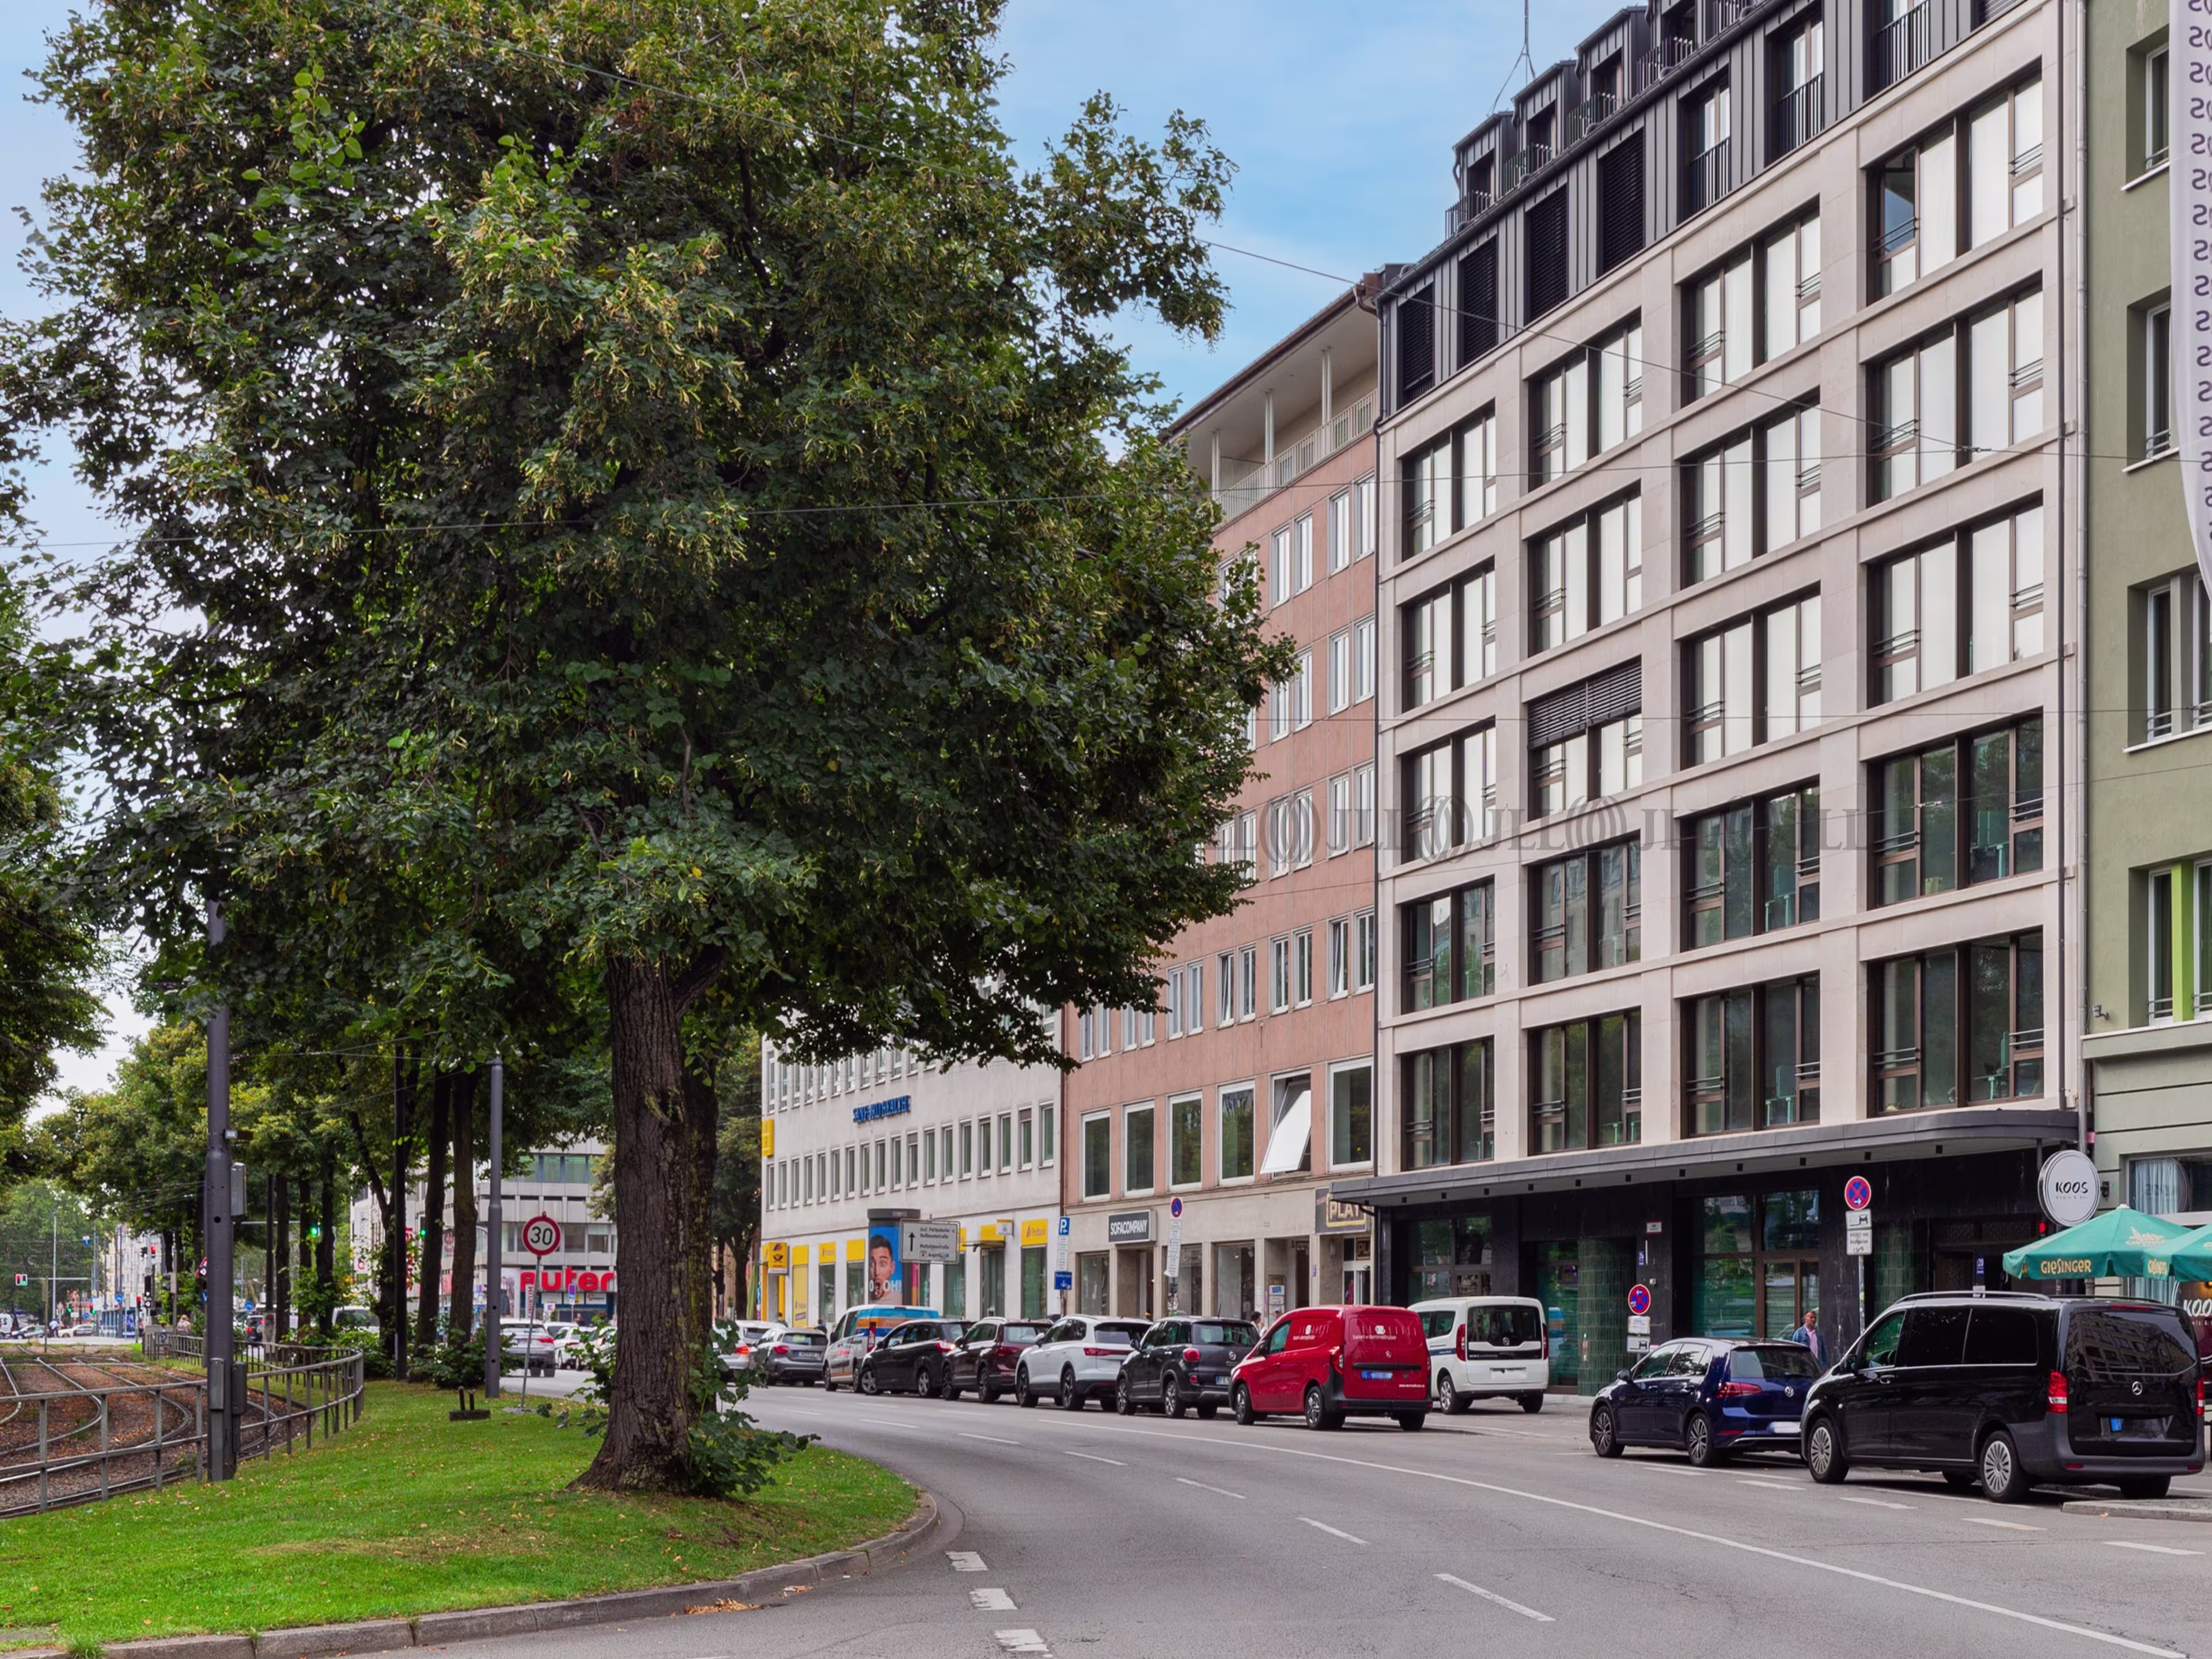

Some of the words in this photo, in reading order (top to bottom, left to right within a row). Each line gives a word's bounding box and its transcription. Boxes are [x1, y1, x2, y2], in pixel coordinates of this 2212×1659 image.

[2055, 1181, 2088, 1194] KOOS
[531, 1226, 553, 1245] 30
[1110, 1219, 1147, 1235] SOFACOMPANY
[2183, 1298, 2212, 1317] KOO
